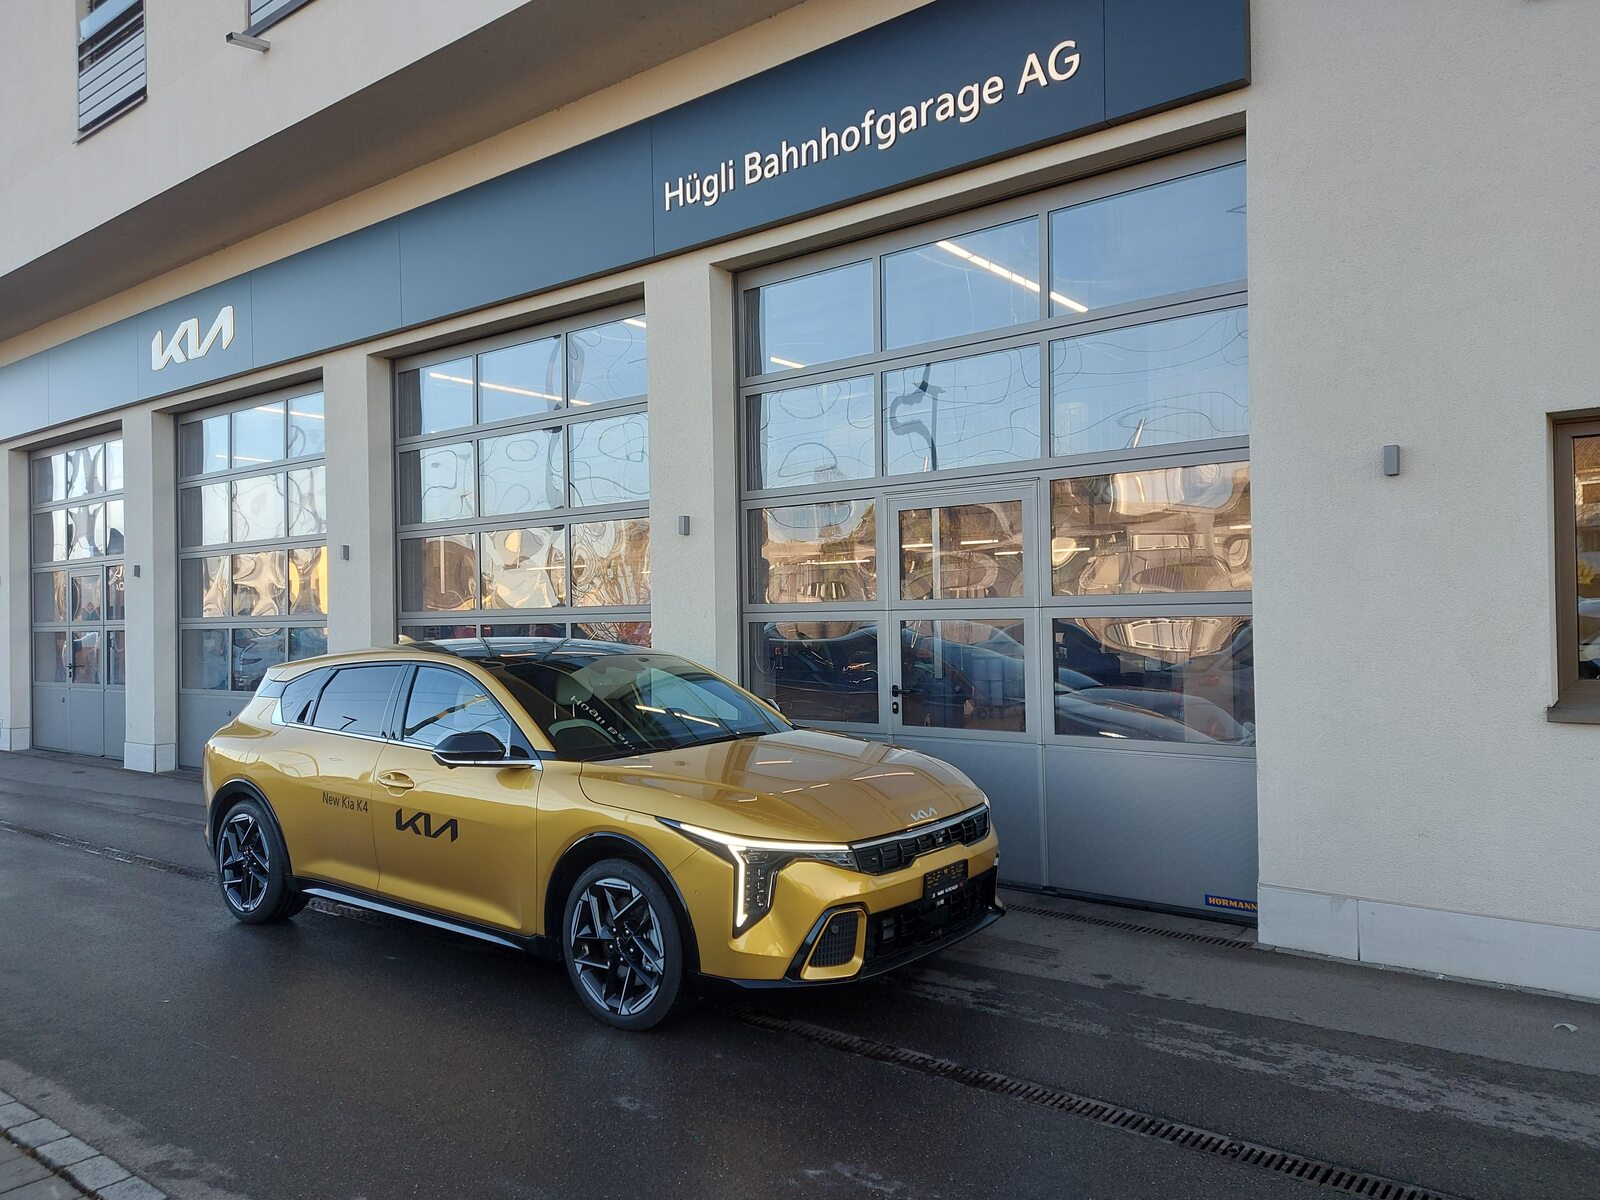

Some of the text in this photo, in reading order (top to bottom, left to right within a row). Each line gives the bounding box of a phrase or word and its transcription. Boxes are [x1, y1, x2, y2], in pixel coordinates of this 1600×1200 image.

[664, 40, 1081, 211] Hügli Bahnhofgarage AG
[151, 305, 234, 371] KIA
[322, 792, 369, 813] New Kia K4
[396, 808, 459, 842] KIA
